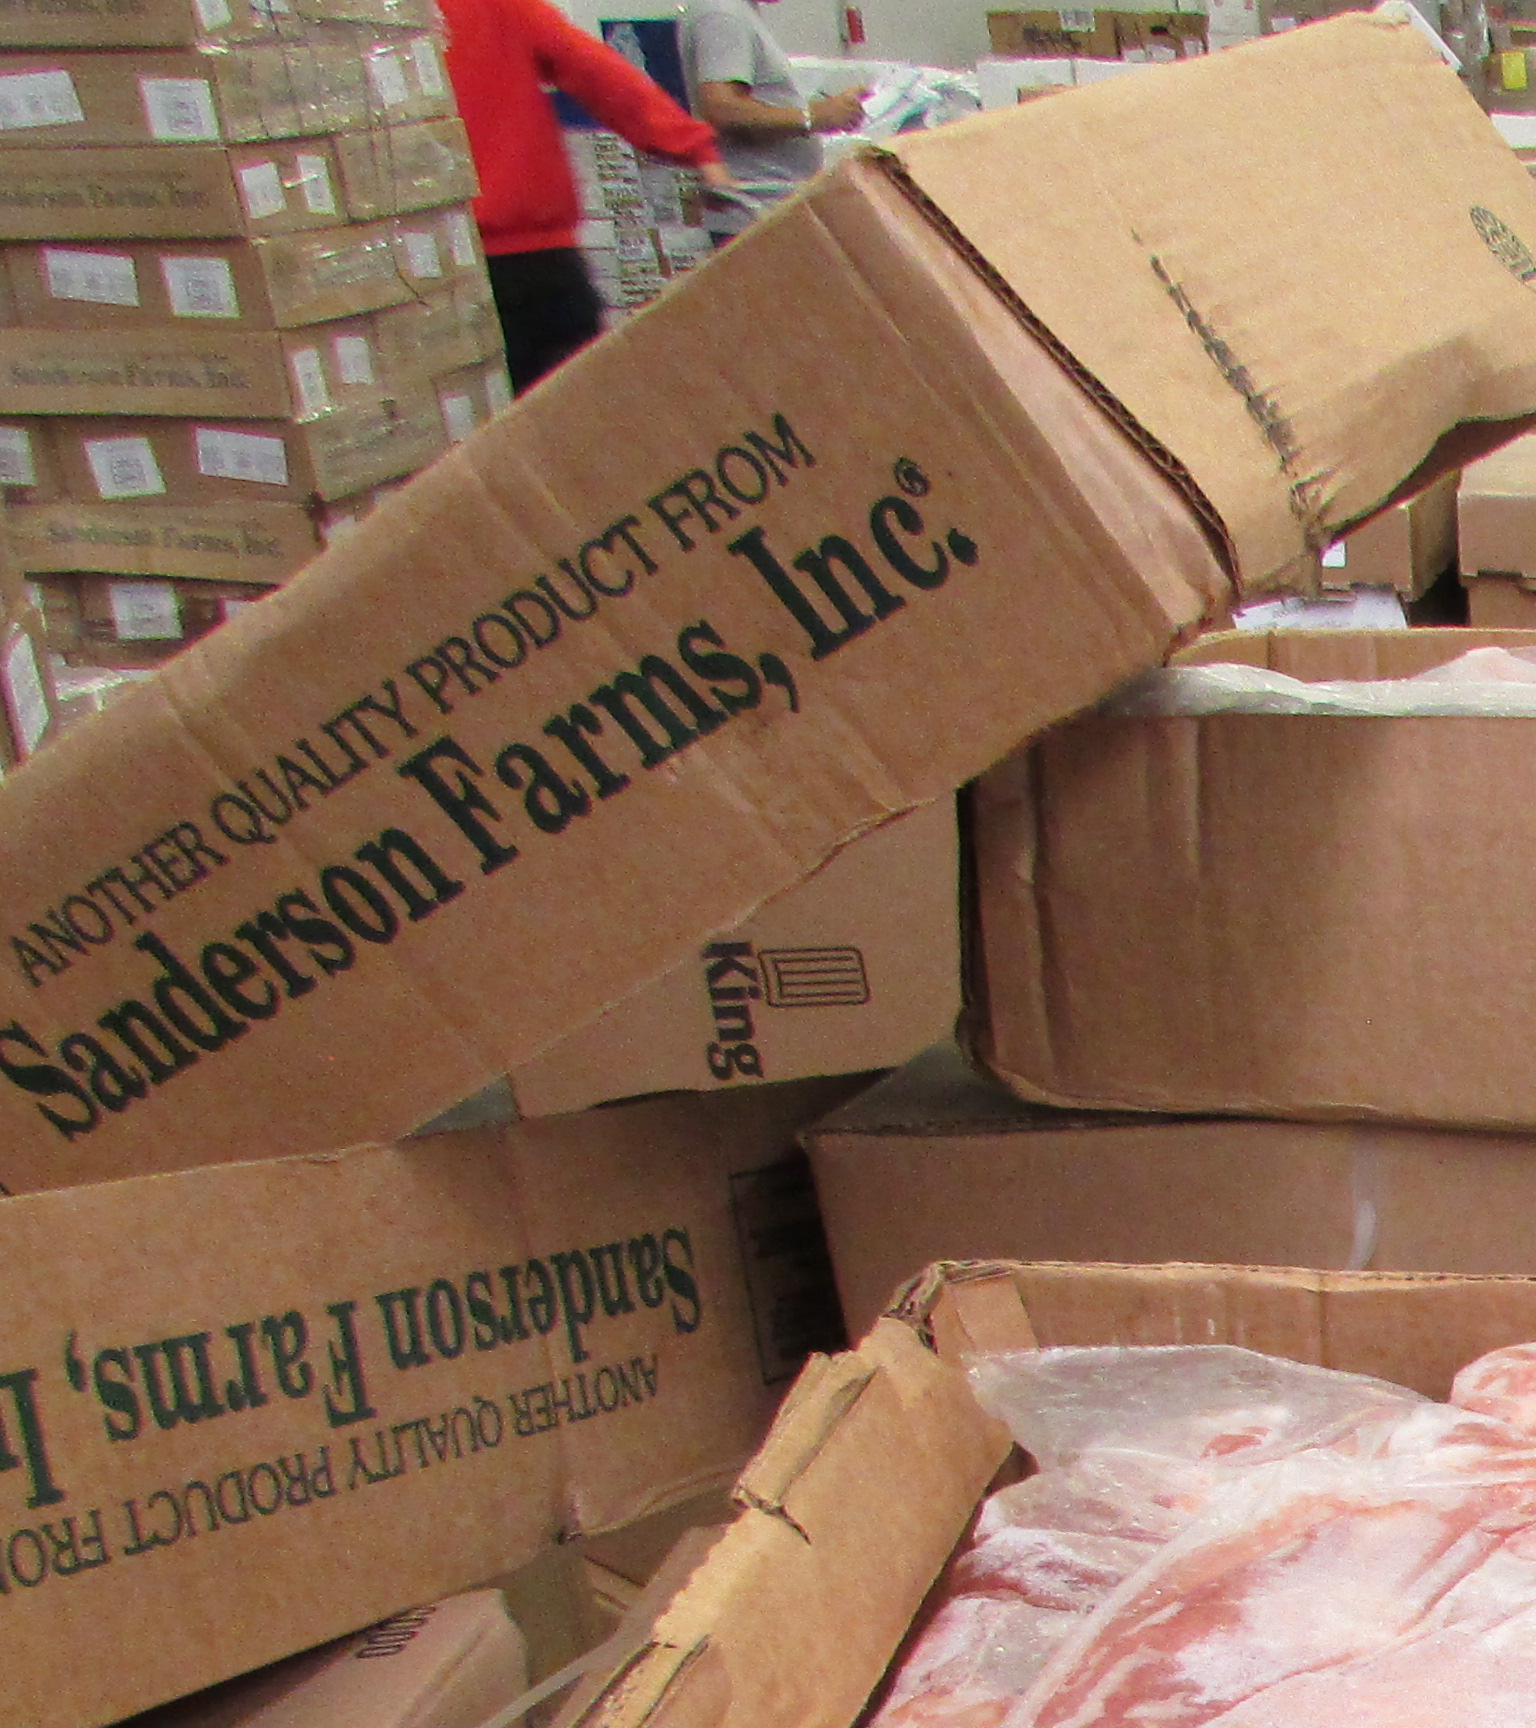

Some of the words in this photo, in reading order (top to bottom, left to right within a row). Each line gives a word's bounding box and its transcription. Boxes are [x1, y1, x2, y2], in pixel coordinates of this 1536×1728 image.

[10, 820, 228, 986] ANOTHER
[210, 679, 418, 847] QUALITY
[406, 514, 665, 715] PRODUCT
[647, 411, 817, 552] FROM
[0, 825, 465, 1142] Sanderson
[397, 618, 801, 877] Farms,
[702, 941, 765, 1080] King
[375, 1226, 703, 1373] Sanderson
[65, 1300, 377, 1445] Farms,
[507, 1352, 662, 1440] ANOTHER
[122, 1442, 335, 1559] PRODUCT
[345, 1402, 506, 1495] QUALITY
[0, 1510, 111, 1598] FRO
